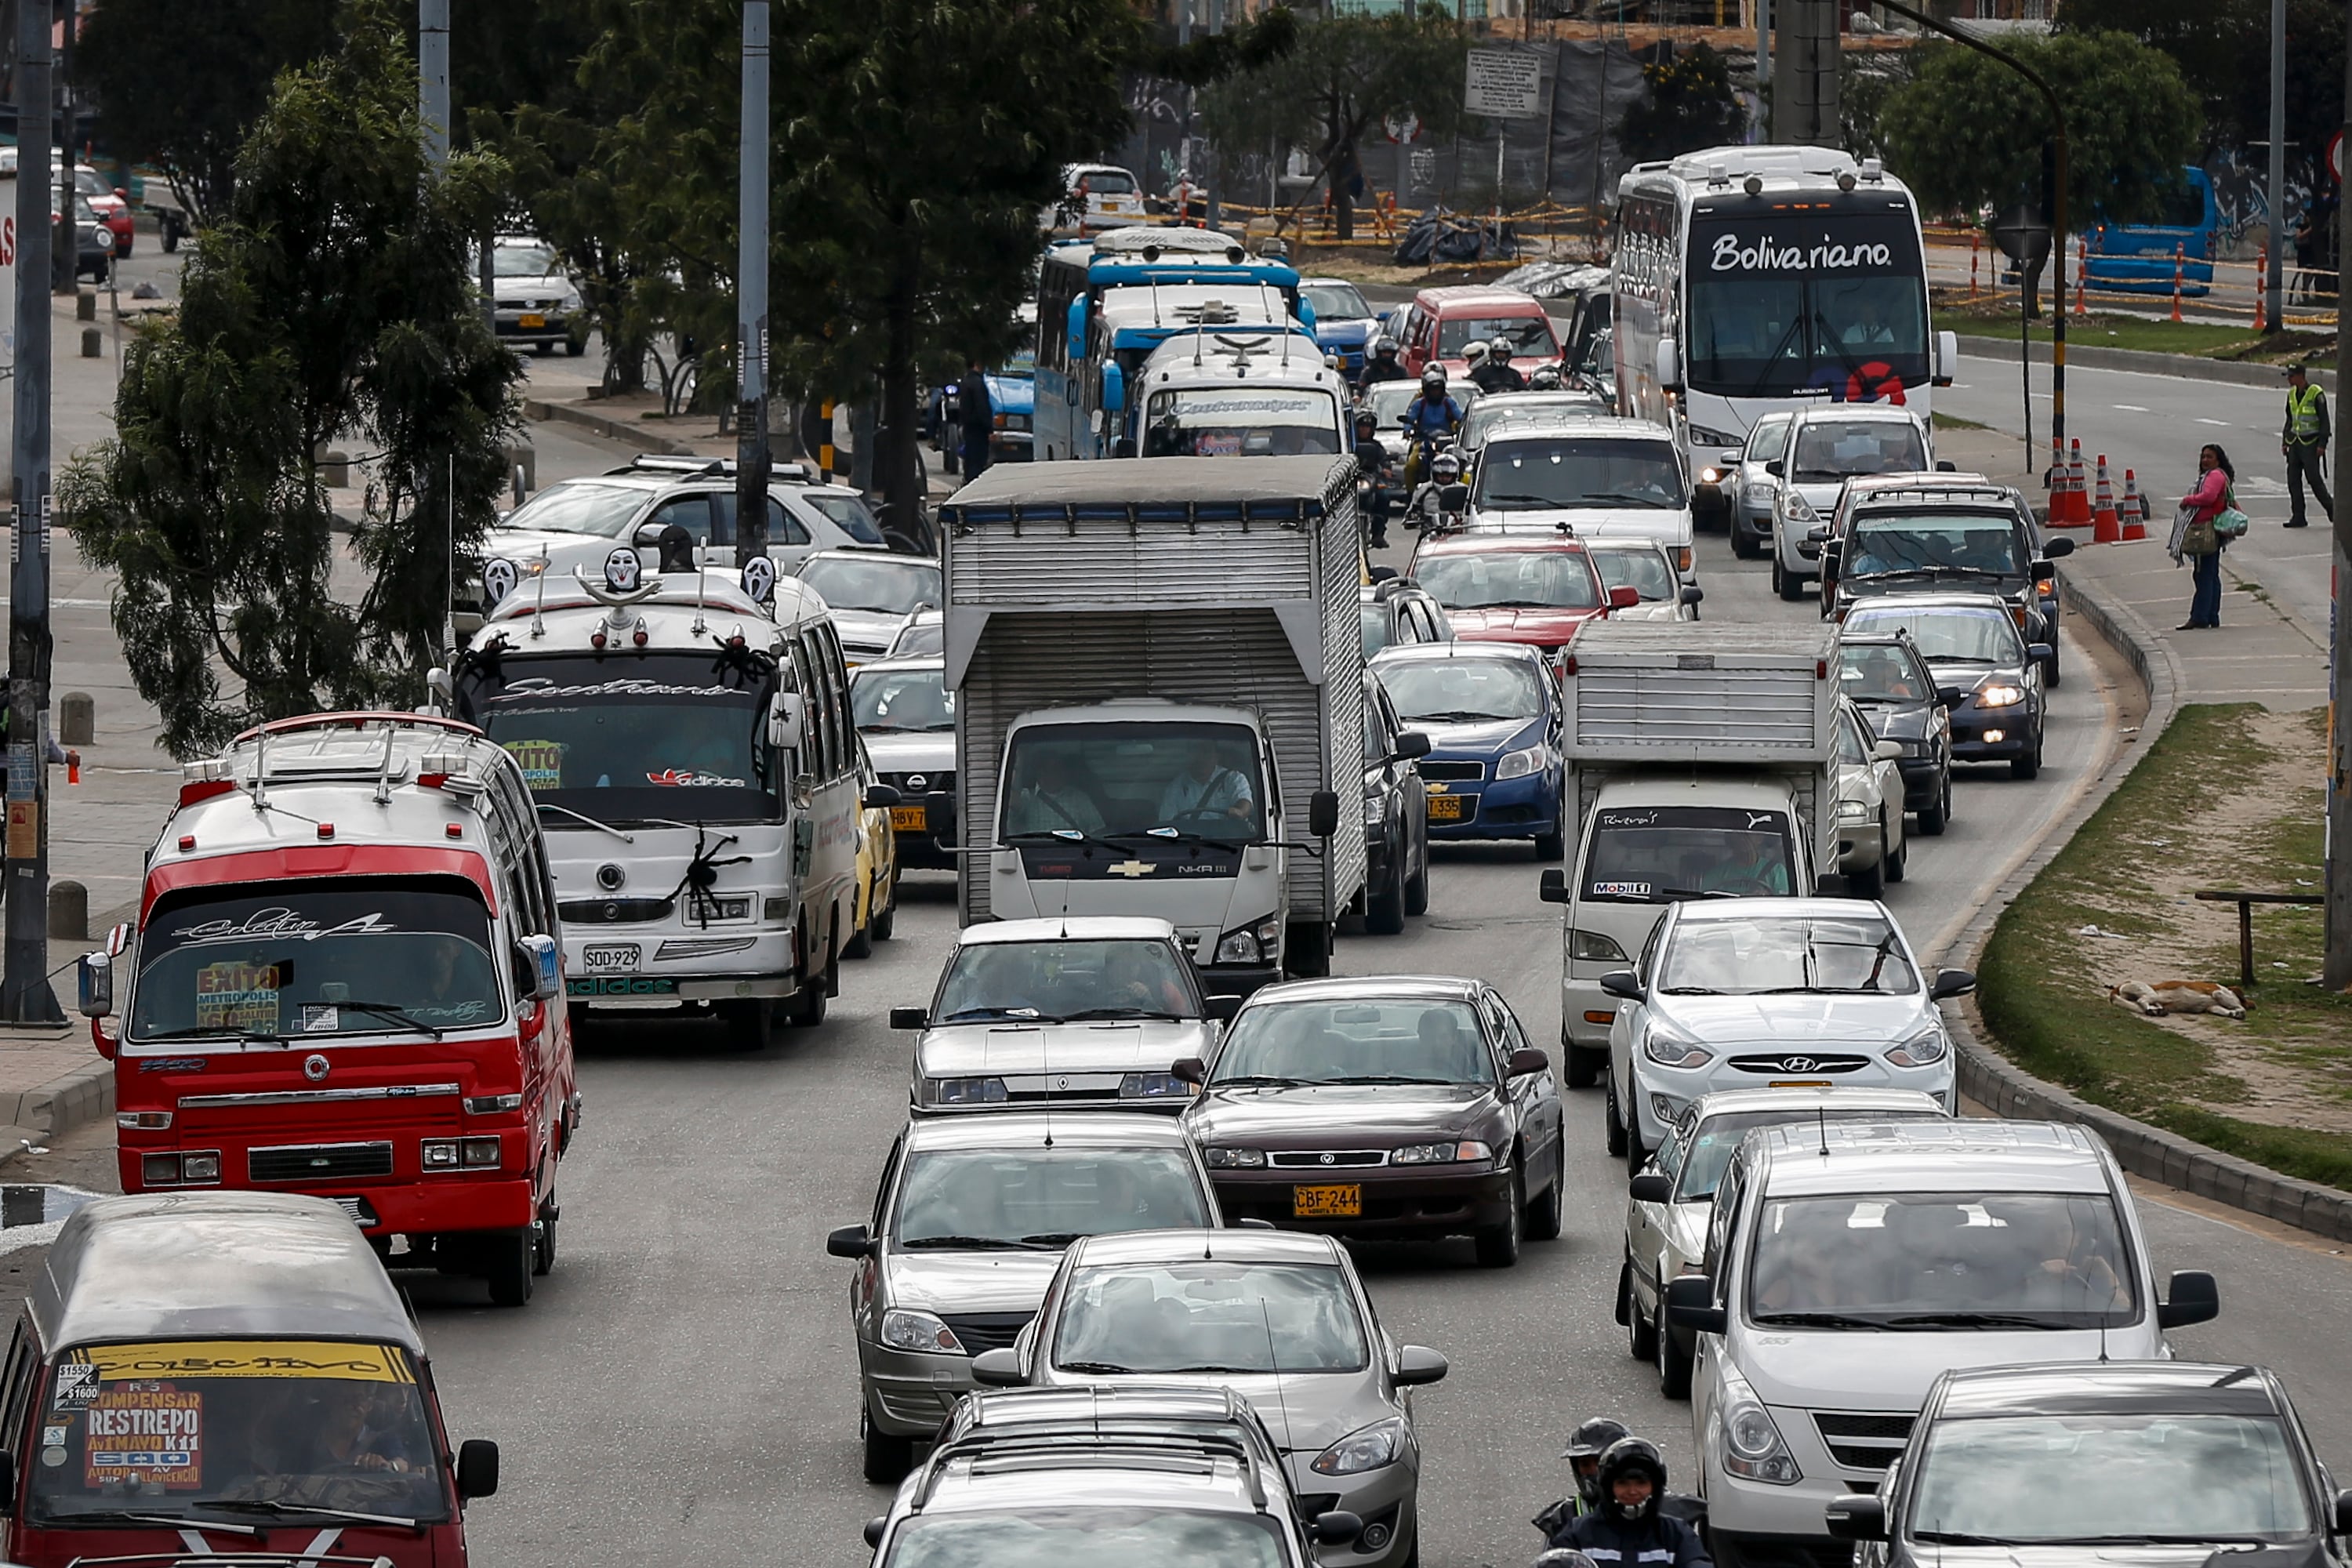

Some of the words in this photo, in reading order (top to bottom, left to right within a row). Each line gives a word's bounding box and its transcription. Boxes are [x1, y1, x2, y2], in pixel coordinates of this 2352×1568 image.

[0, 216, 14, 267] S
[1711, 233, 1889, 270] Bolivariano
[510, 747, 560, 770] XITO
[523, 770, 559, 779] OPOLIS
[677, 775, 745, 787] adidas
[1429, 800, 1458, 812] T-335
[892, 811, 924, 824] HBV-7
[1040, 865, 1073, 873] TURBO
[1595, 884, 1634, 893] Mobil
[198, 967, 278, 994] EXITO
[198, 991, 278, 1005] METROPOLIS
[1297, 1189, 1358, 1208] CBF-244
[60, 1365, 89, 1376] $1550
[67, 1387, 97, 1399] $1600
[89, 1409, 198, 1436] RESTREPO
[95, 1453, 188, 1465] SAO
